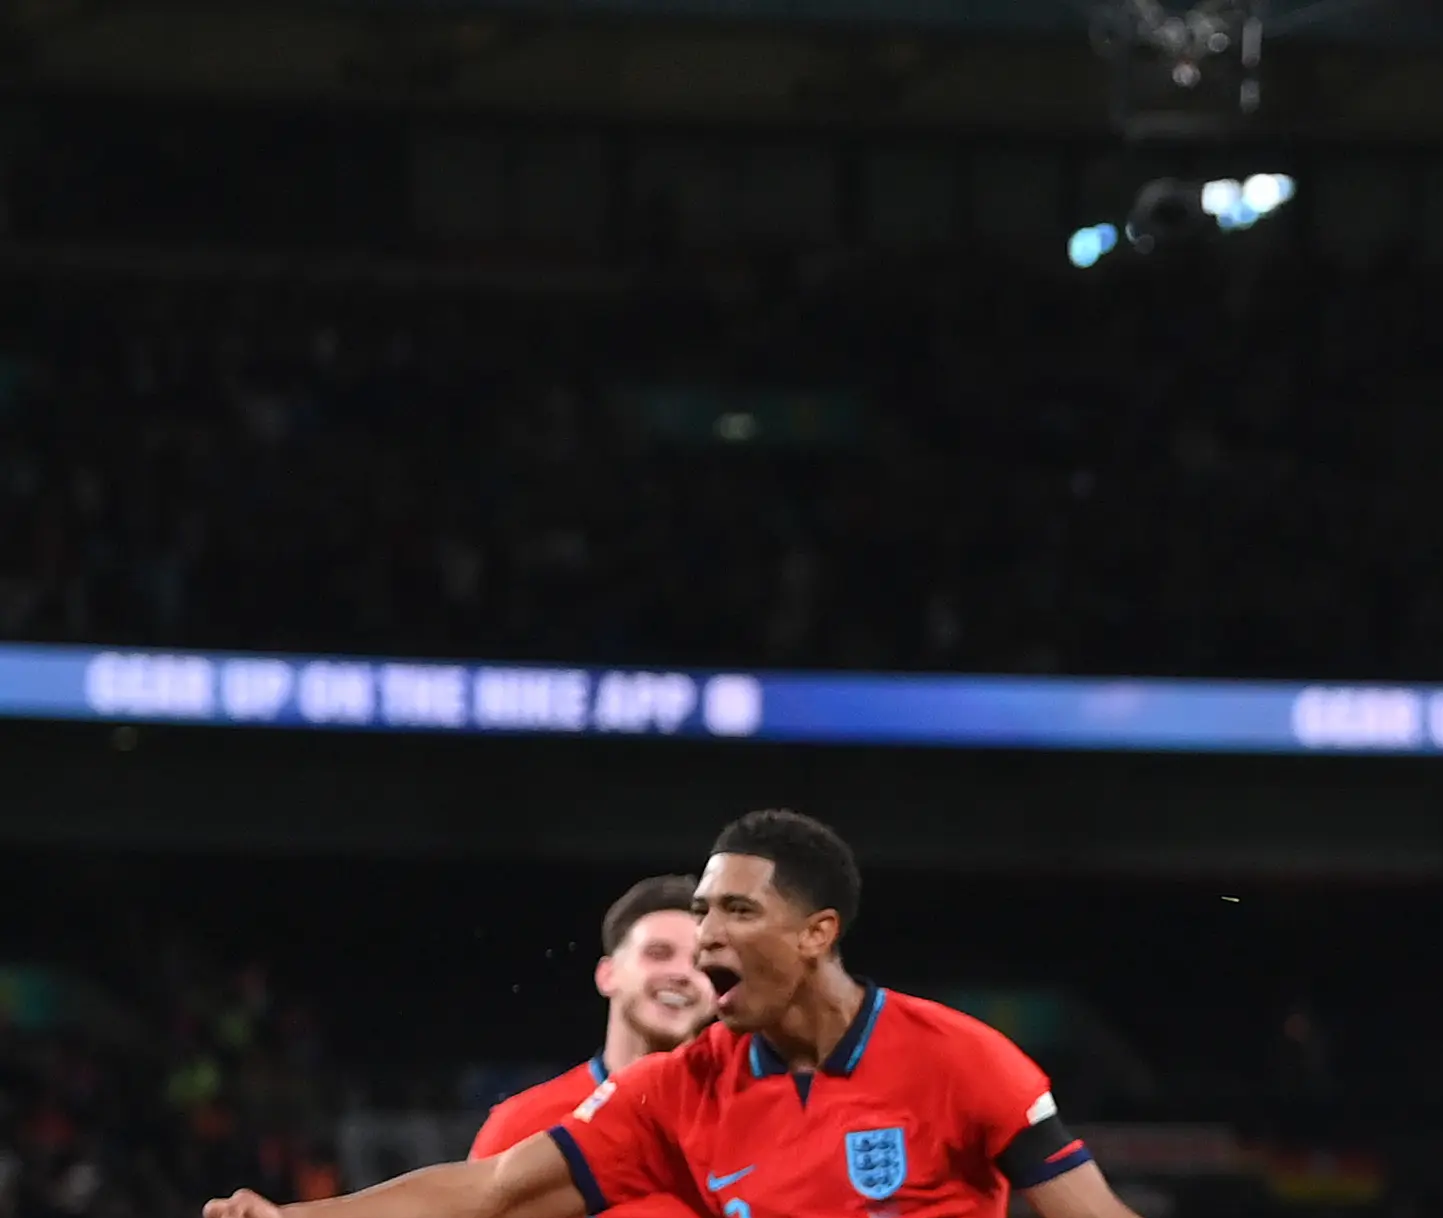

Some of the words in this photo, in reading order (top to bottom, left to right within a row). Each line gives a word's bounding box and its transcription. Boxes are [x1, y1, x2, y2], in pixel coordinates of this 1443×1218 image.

[220, 659, 294, 719] UP
[298, 661, 375, 721] ON
[379, 664, 466, 726] THE
[473, 667, 588, 730] NIKE
[595, 673, 695, 732] APP
